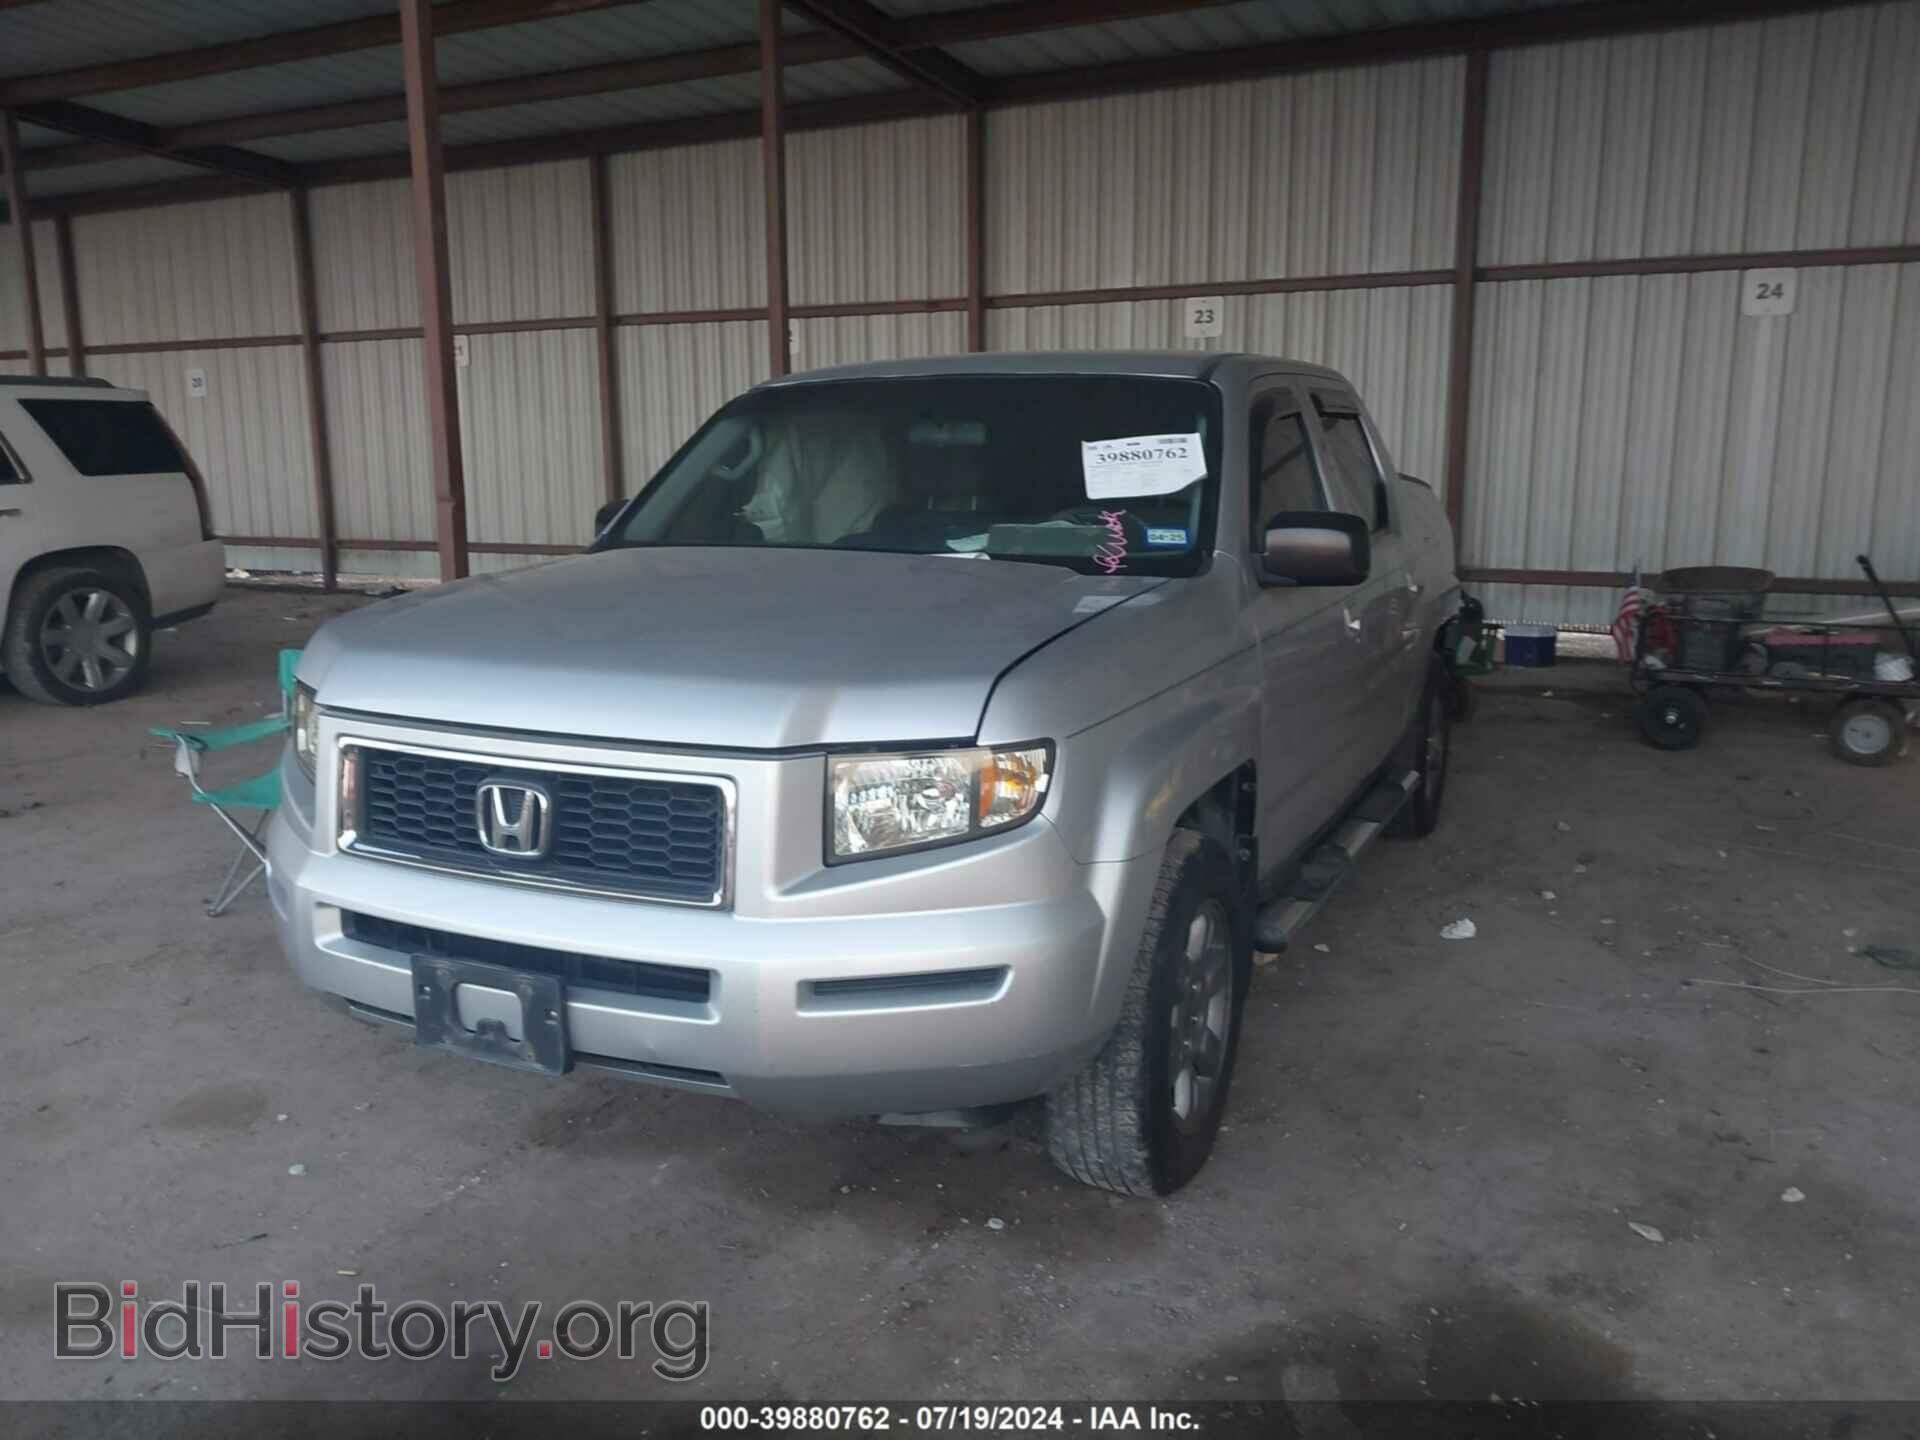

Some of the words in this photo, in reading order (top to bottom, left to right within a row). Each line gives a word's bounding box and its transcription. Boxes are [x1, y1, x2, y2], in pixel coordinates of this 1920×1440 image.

[1756, 282, 1785, 300] 24
[1193, 309, 1215, 324] 23
[1096, 447, 1188, 464] 39880762
